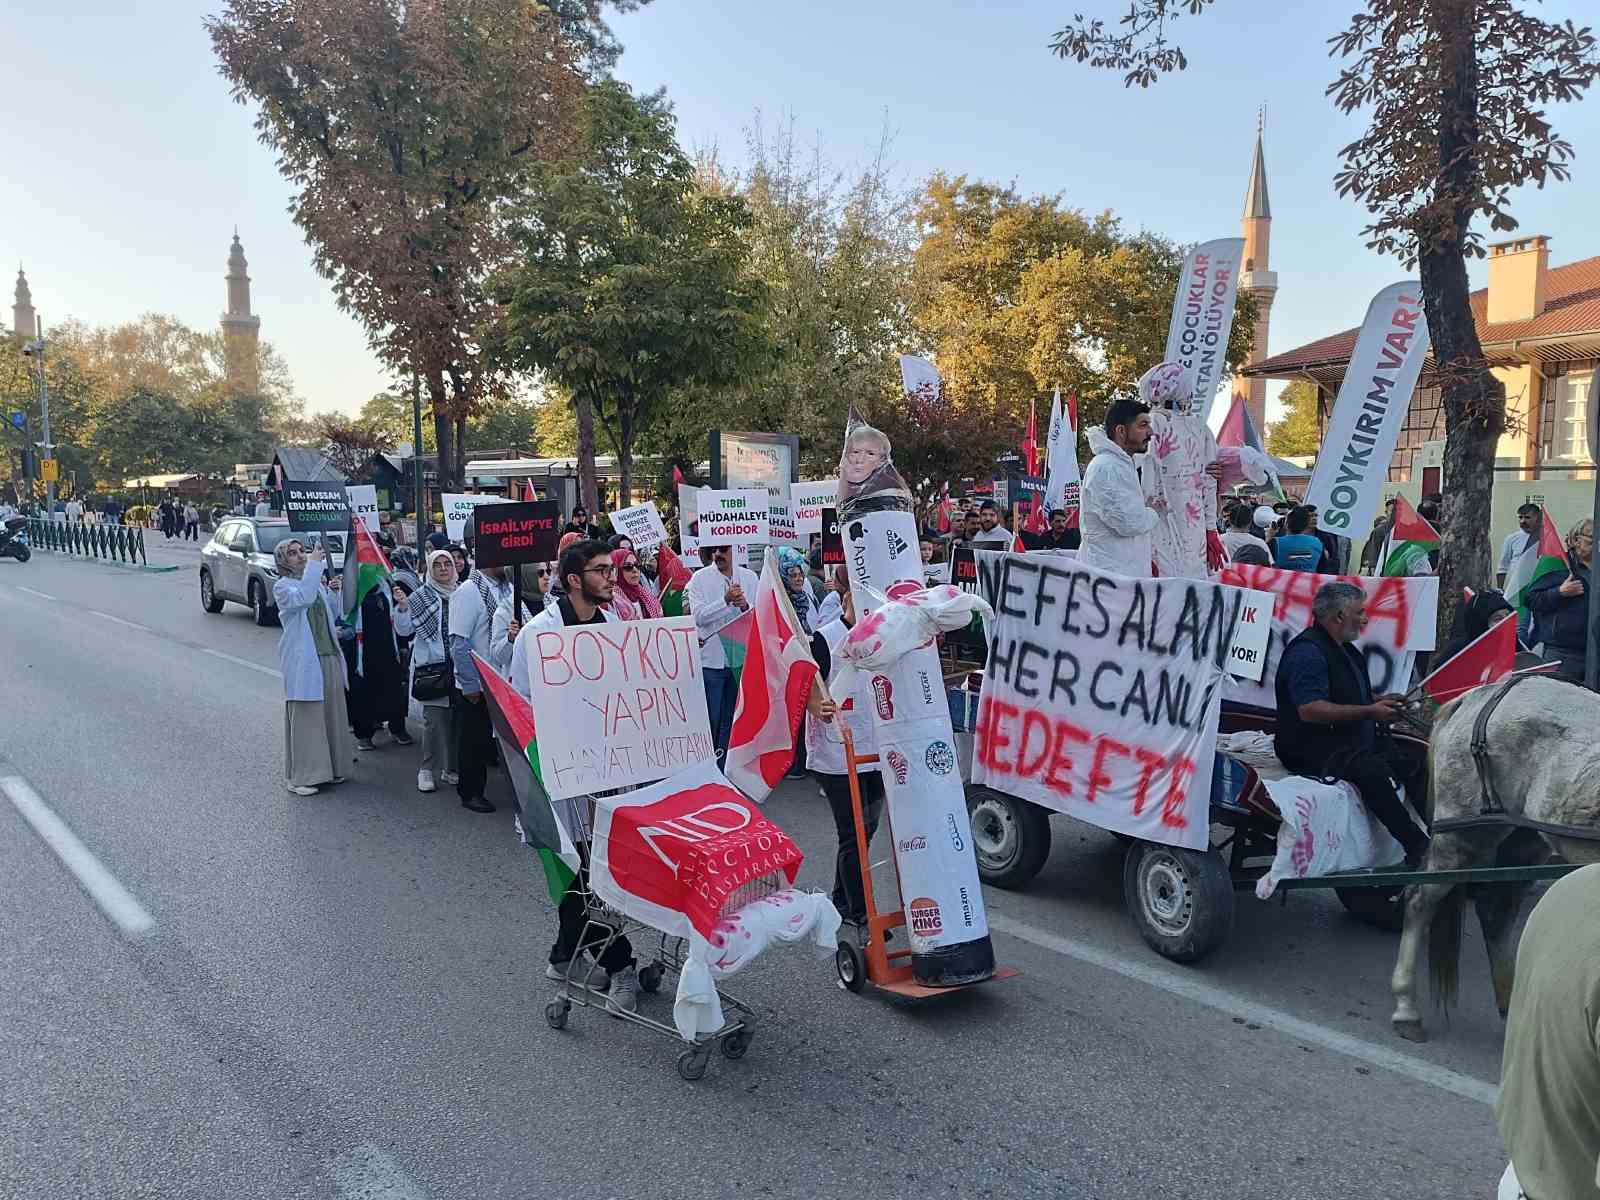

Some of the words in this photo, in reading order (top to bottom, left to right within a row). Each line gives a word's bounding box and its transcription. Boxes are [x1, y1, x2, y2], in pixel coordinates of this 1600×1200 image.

[1180, 253, 1211, 357] ÇOCUKLAR
[1192, 350, 1217, 418] LIKTAN
[1323, 376, 1395, 529] SOYKIRIM
[290, 490, 305, 500] DR.
[306, 490, 341, 500] HUSSAM
[720, 496, 746, 509] TIBBİ
[800, 495, 824, 506] NABIZ
[824, 495, 838, 504] VA
[288, 502, 305, 511] EBU
[796, 507, 822, 519] VİCDA
[700, 510, 768, 524] MÜDAHALEYE
[480, 519, 519, 535] İSRAİL
[711, 524, 758, 536] KORİDOR
[501, 533, 534, 548] GİRDİ
[886, 529, 897, 561] adidas
[1241, 606, 1257, 624] IK
[536, 627, 696, 686] BOYKOT
[1231, 646, 1257, 664] YOR!
[582, 687, 688, 737] YAPIN
[911, 907, 941, 918] BURGER
[960, 887, 973, 927] amazon
[912, 917, 943, 930] KING
